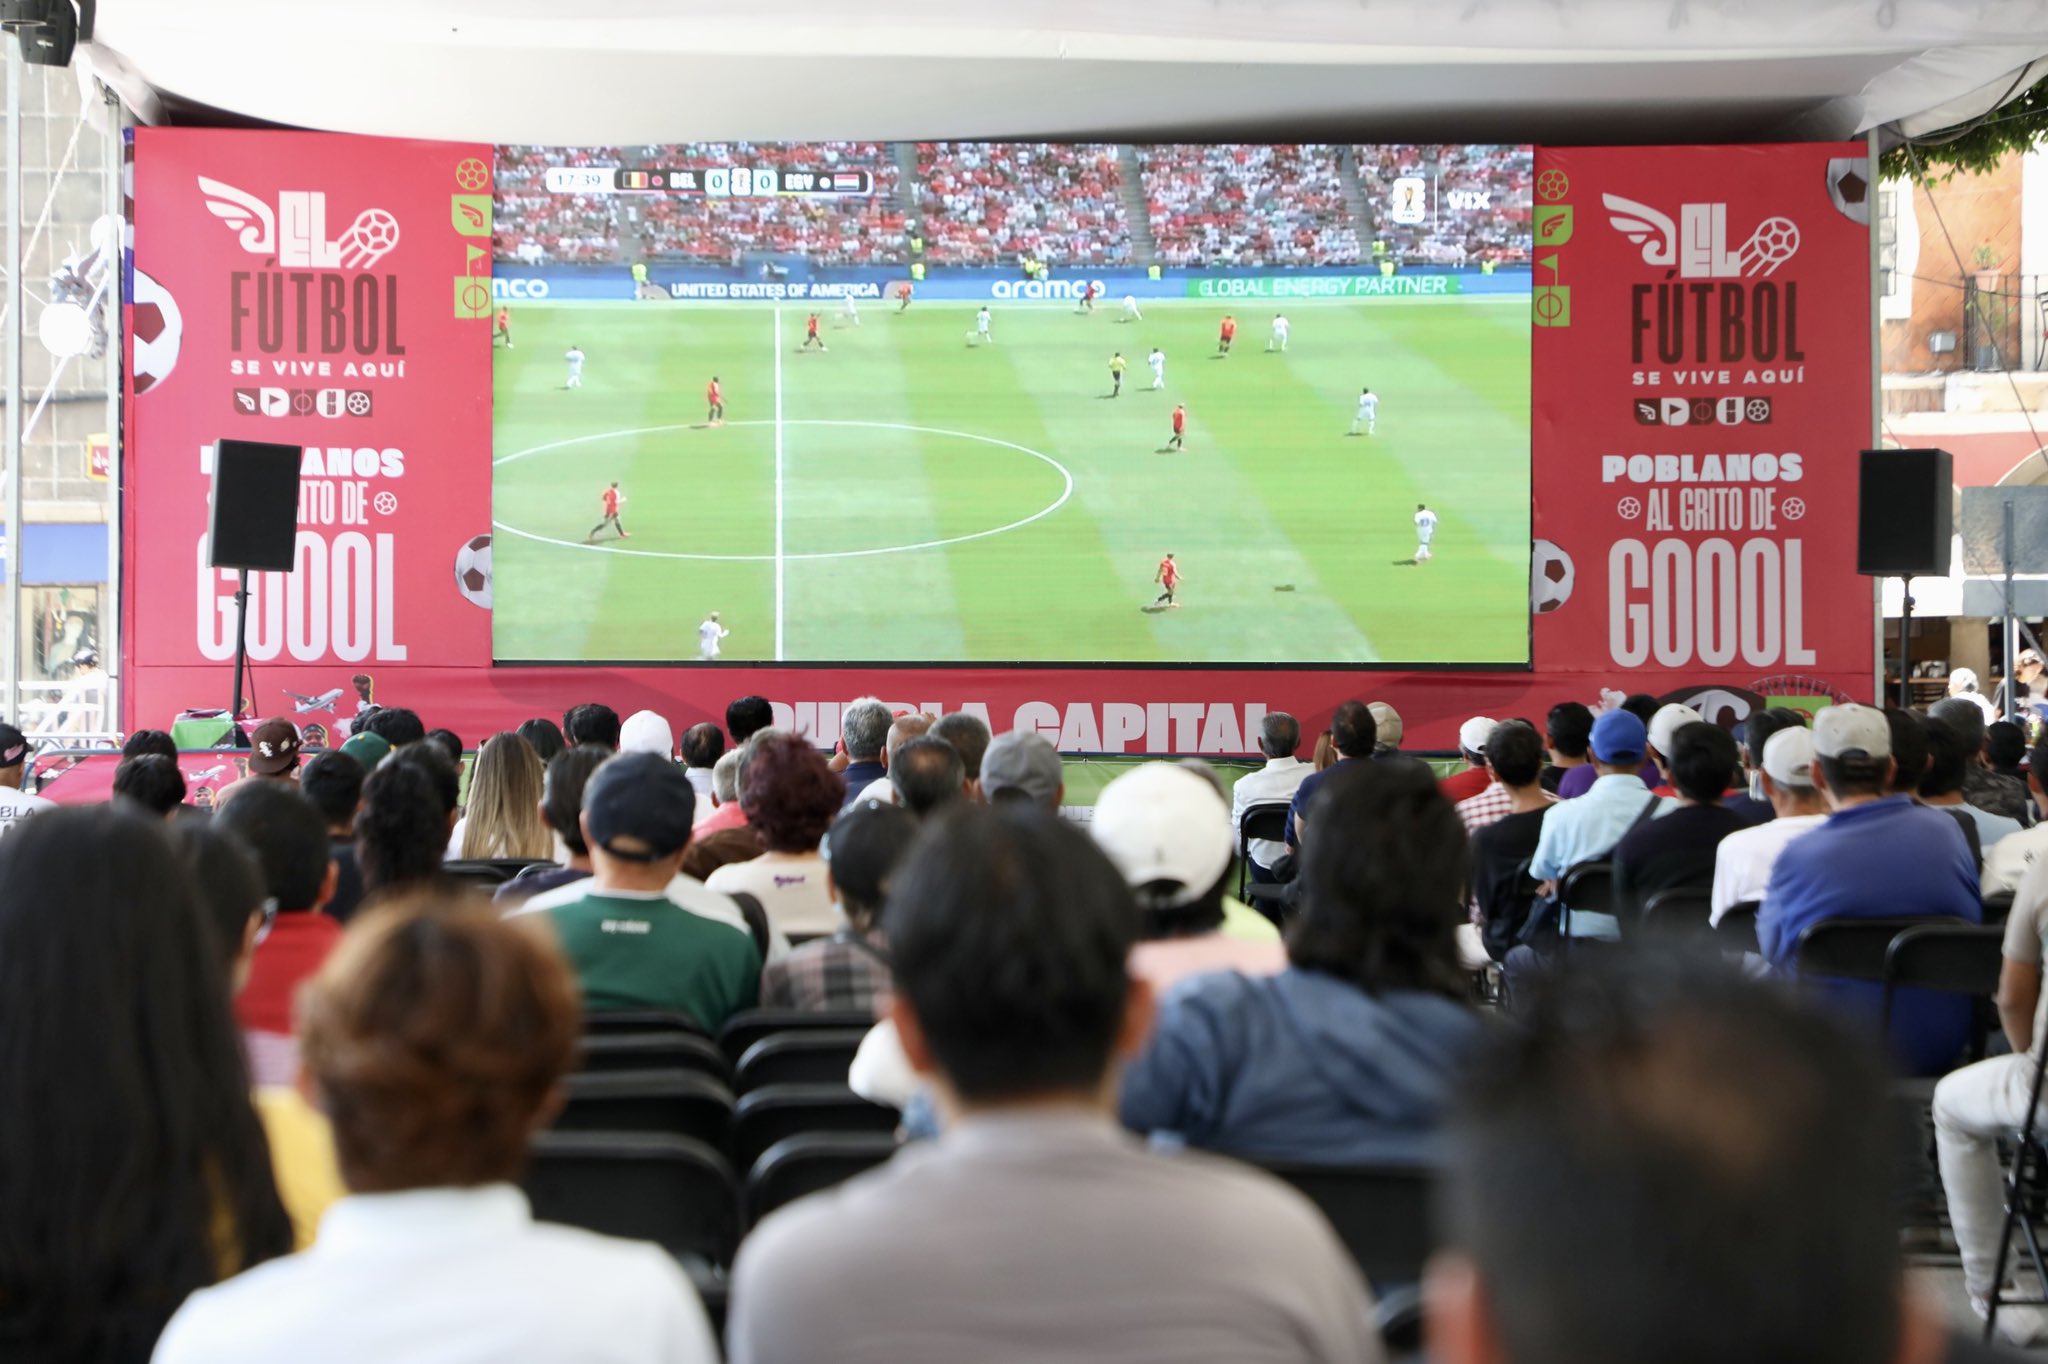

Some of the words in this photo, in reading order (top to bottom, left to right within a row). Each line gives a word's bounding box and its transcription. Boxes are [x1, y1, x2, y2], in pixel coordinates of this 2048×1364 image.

[671, 283, 728, 297] UNITED
[729, 283, 786, 298] STATES
[787, 283, 807, 297] OF
[810, 283, 880, 298] AMERICA
[991, 280, 1106, 298] aramco
[1199, 278, 1268, 297] GLOBAL
[1272, 277, 1351, 297] ENERGY
[1355, 276, 1447, 294] PARTNER
[231, 258, 406, 356] FÚTBOL
[1632, 270, 1805, 365] FÚTBOL
[231, 360, 260, 375] SE
[272, 361, 331, 376] VIVE
[343, 359, 406, 378] AQUÍ
[1632, 371, 1661, 386] SE
[1673, 370, 1731, 385] VIVE
[1743, 366, 1805, 384] AQUÍ
[1602, 453, 1803, 483] POBLANOS
[297, 480, 335, 525] ITO
[342, 480, 369, 525] DE
[1646, 488, 1673, 531] AL
[1679, 487, 1743, 531] GRITO
[1750, 487, 1777, 530] DE
[197, 531, 408, 661] GOOOL
[1608, 537, 1816, 668] GOOOL
